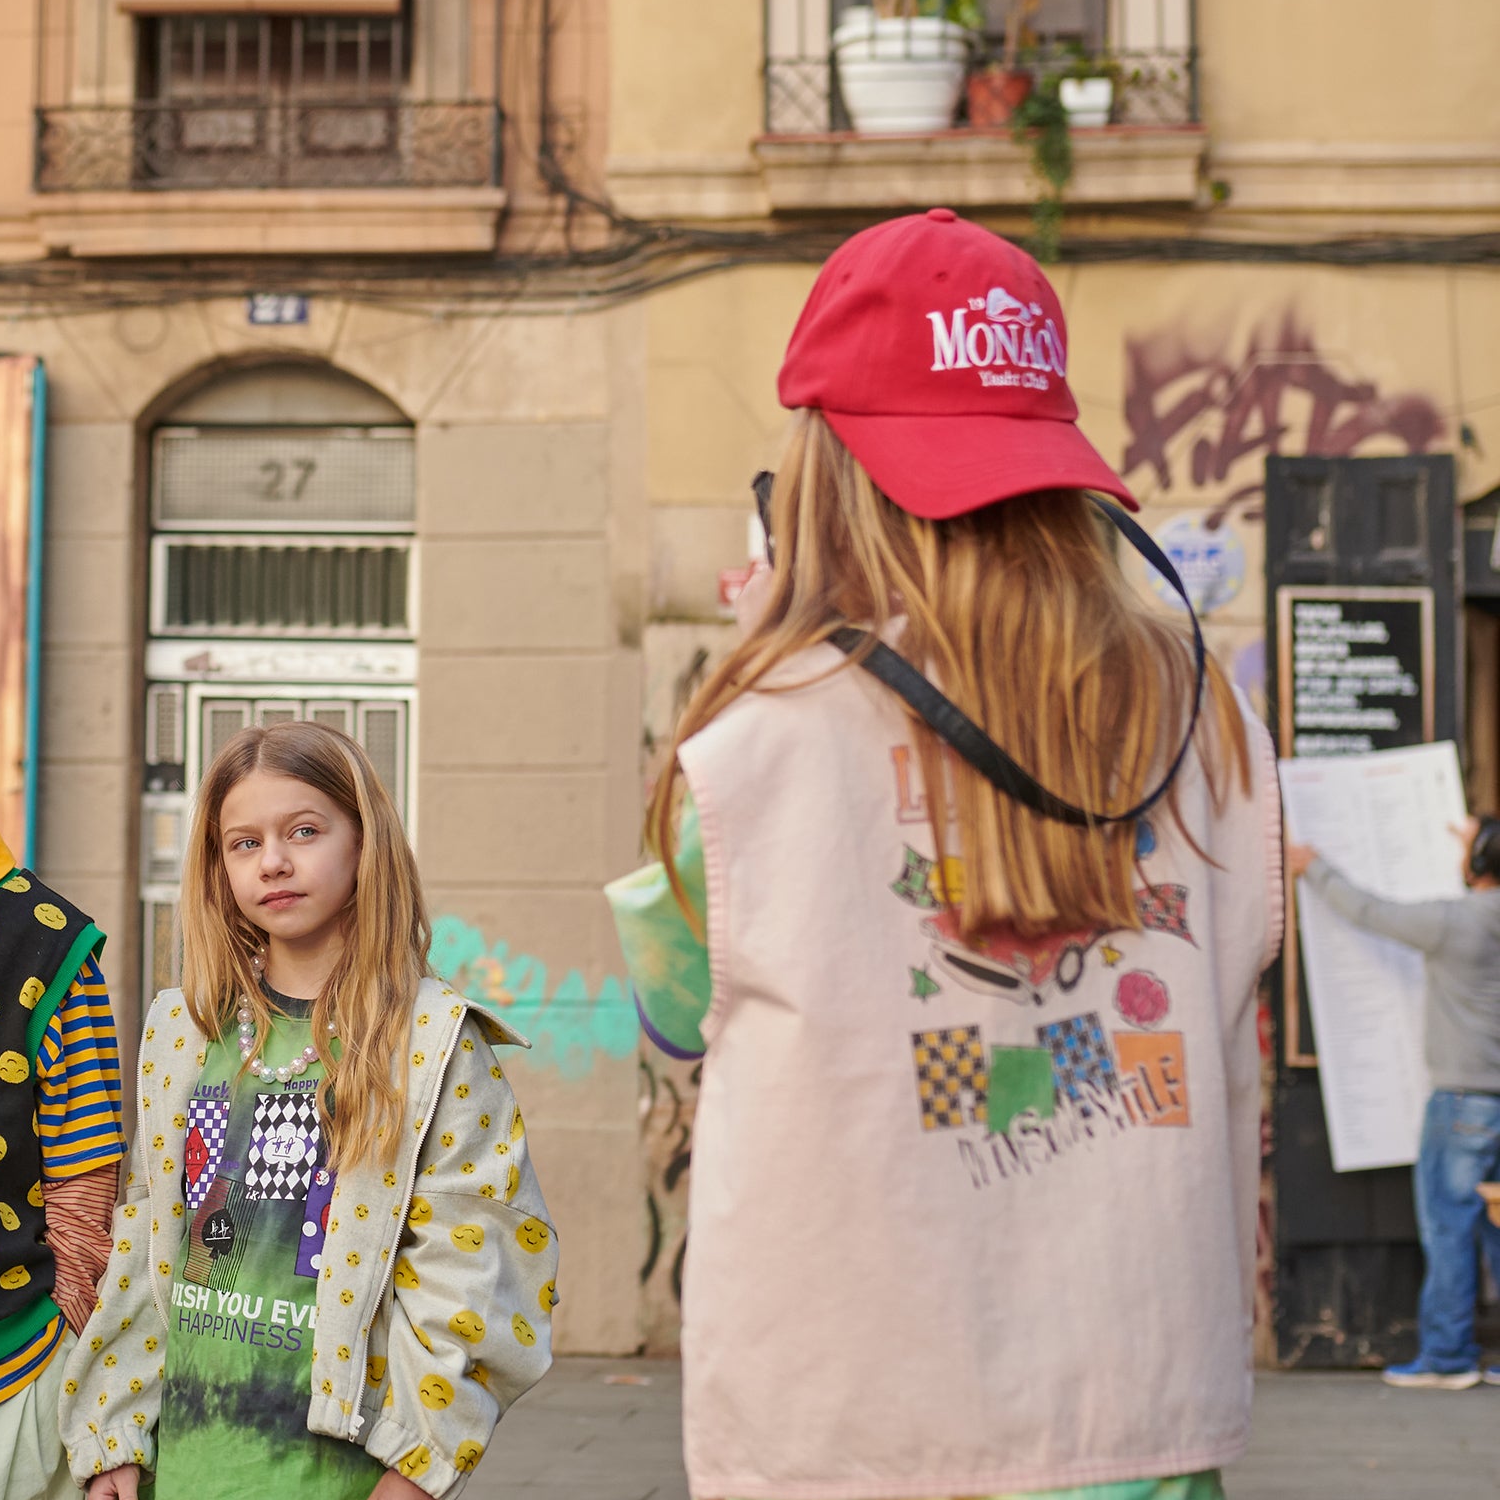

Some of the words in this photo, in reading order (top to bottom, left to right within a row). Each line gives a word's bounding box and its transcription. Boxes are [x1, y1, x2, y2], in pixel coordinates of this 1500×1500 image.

[258, 458, 317, 502] 27
[283, 1077, 320, 1092] Happy
[216, 1288, 263, 1320] YOU
[178, 1308, 304, 1352] HAPPINESS
